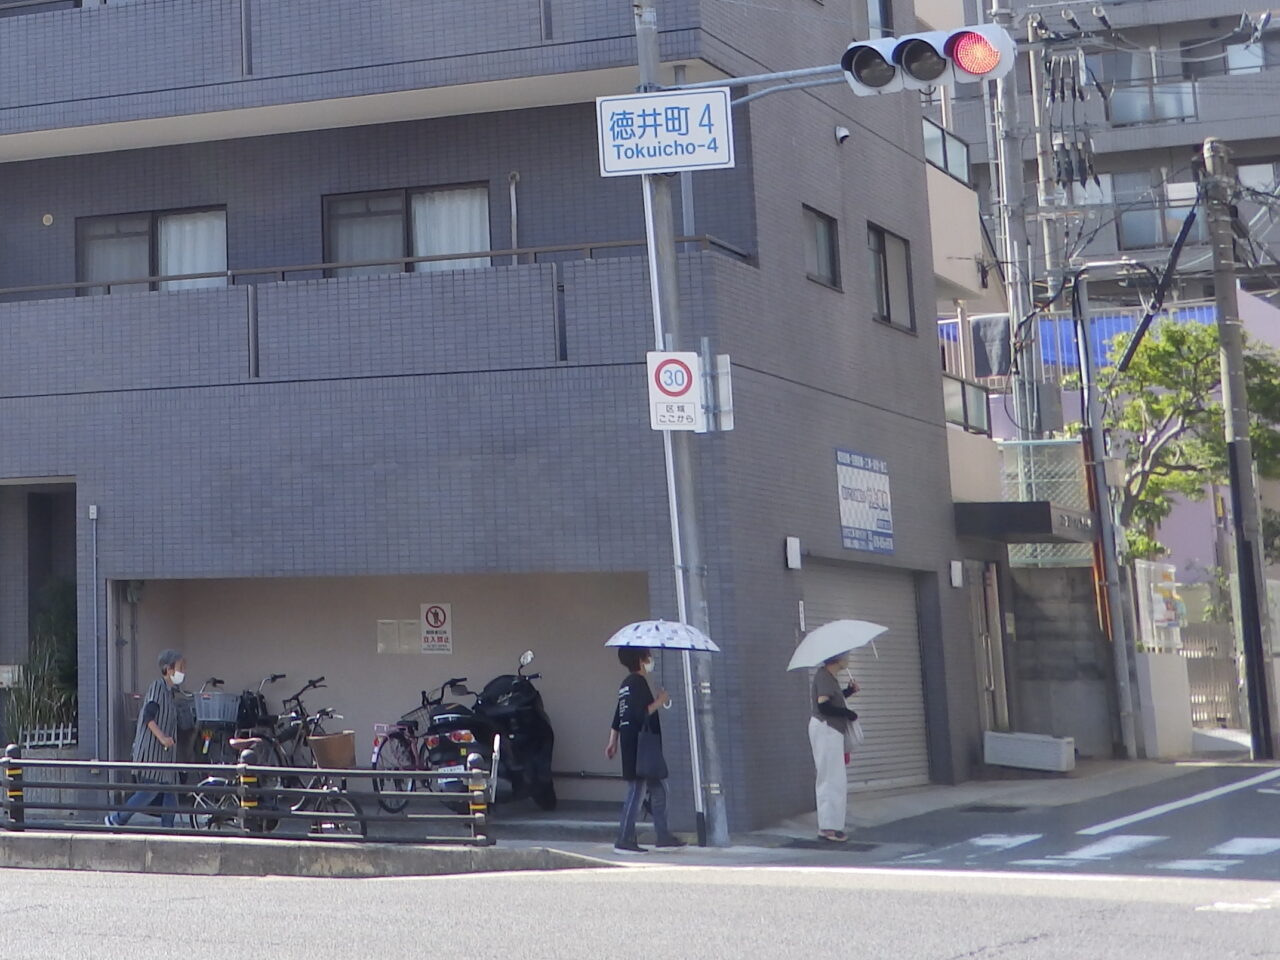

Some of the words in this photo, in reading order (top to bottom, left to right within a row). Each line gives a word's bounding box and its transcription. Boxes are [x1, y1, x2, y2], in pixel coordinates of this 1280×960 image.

[609, 107, 690, 141] 徳井町
[698, 103, 714, 135] 4
[612, 137, 719, 160] Tokuicho-4
[663, 369, 684, 387] 30
[659, 414, 694, 424] ここから
